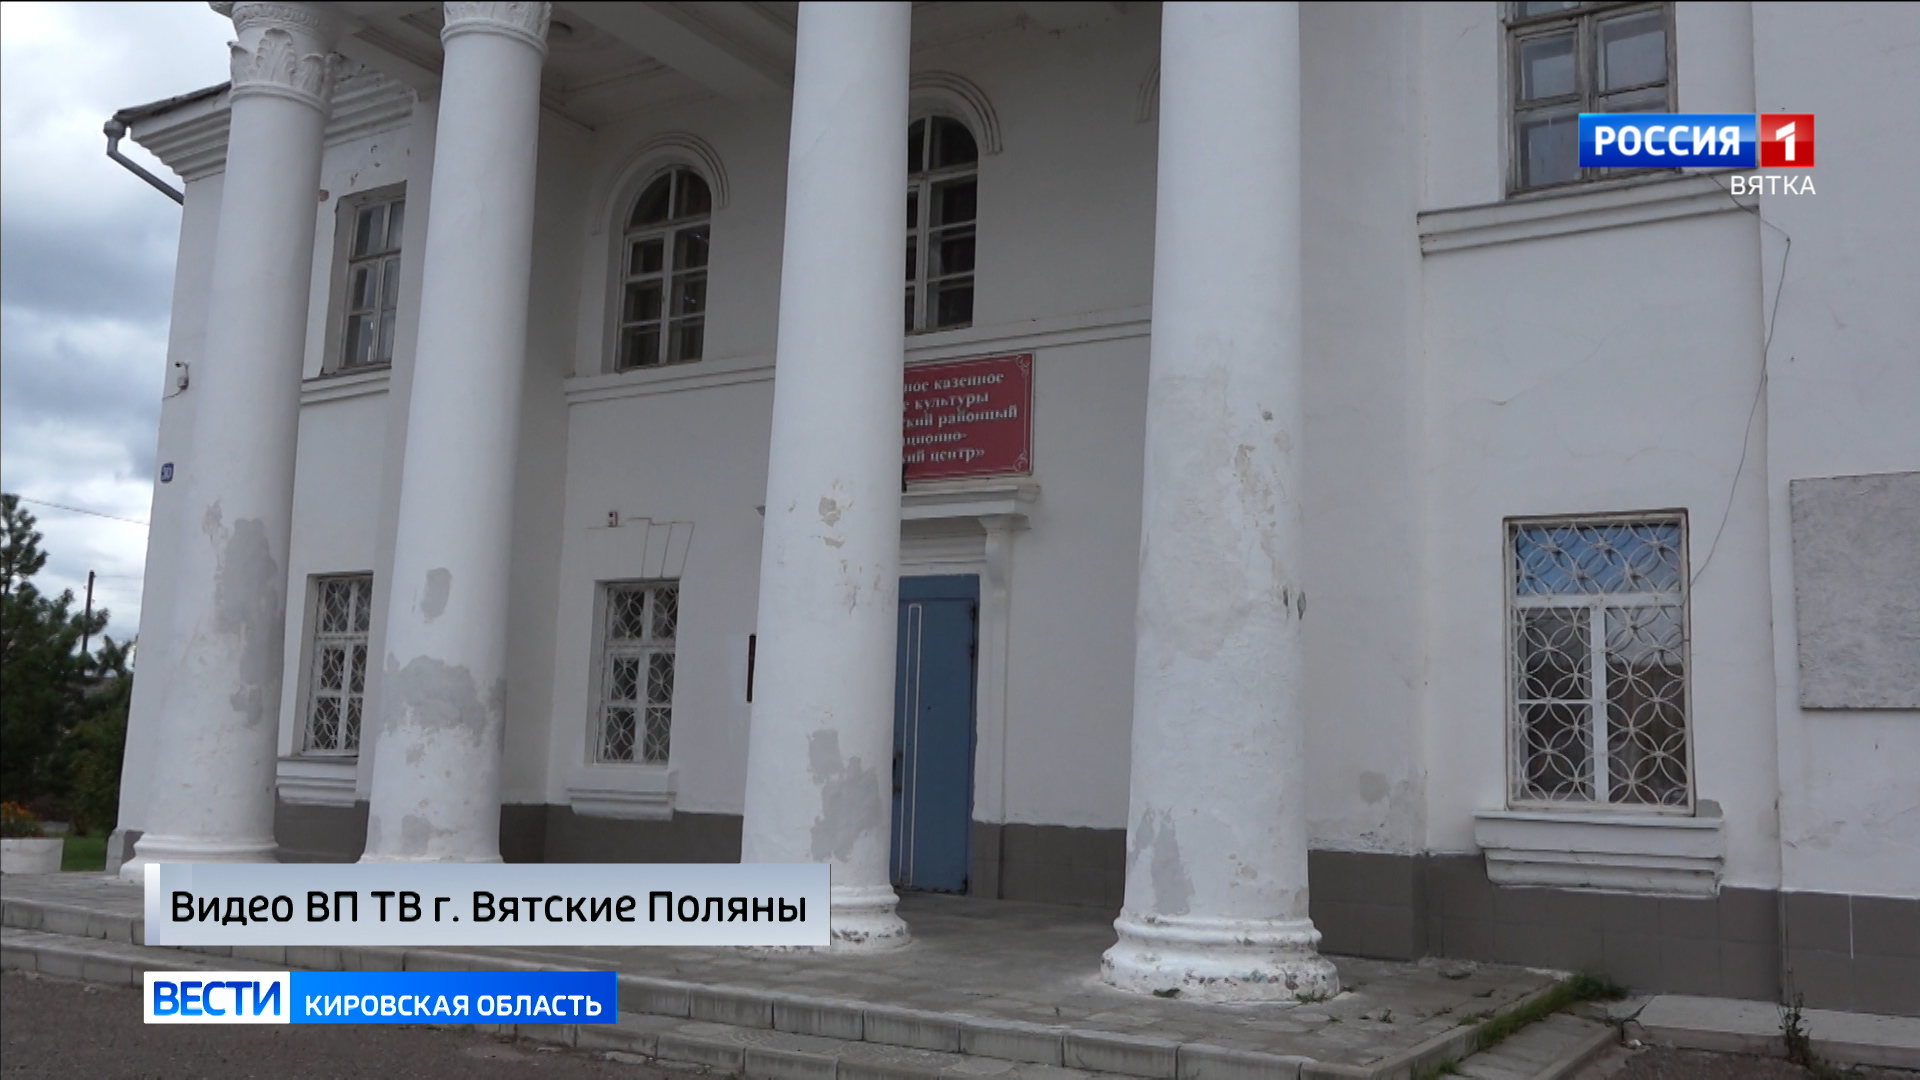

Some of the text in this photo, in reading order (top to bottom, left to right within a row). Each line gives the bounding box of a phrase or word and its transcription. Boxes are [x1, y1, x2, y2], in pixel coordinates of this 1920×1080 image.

[904, 373, 1004, 393] ное казенное
[915, 392, 989, 411] культуры
[904, 405, 1018, 428] кий районный
[905, 431, 966, 447] ционно-
[930, 447, 985, 463] центр»
